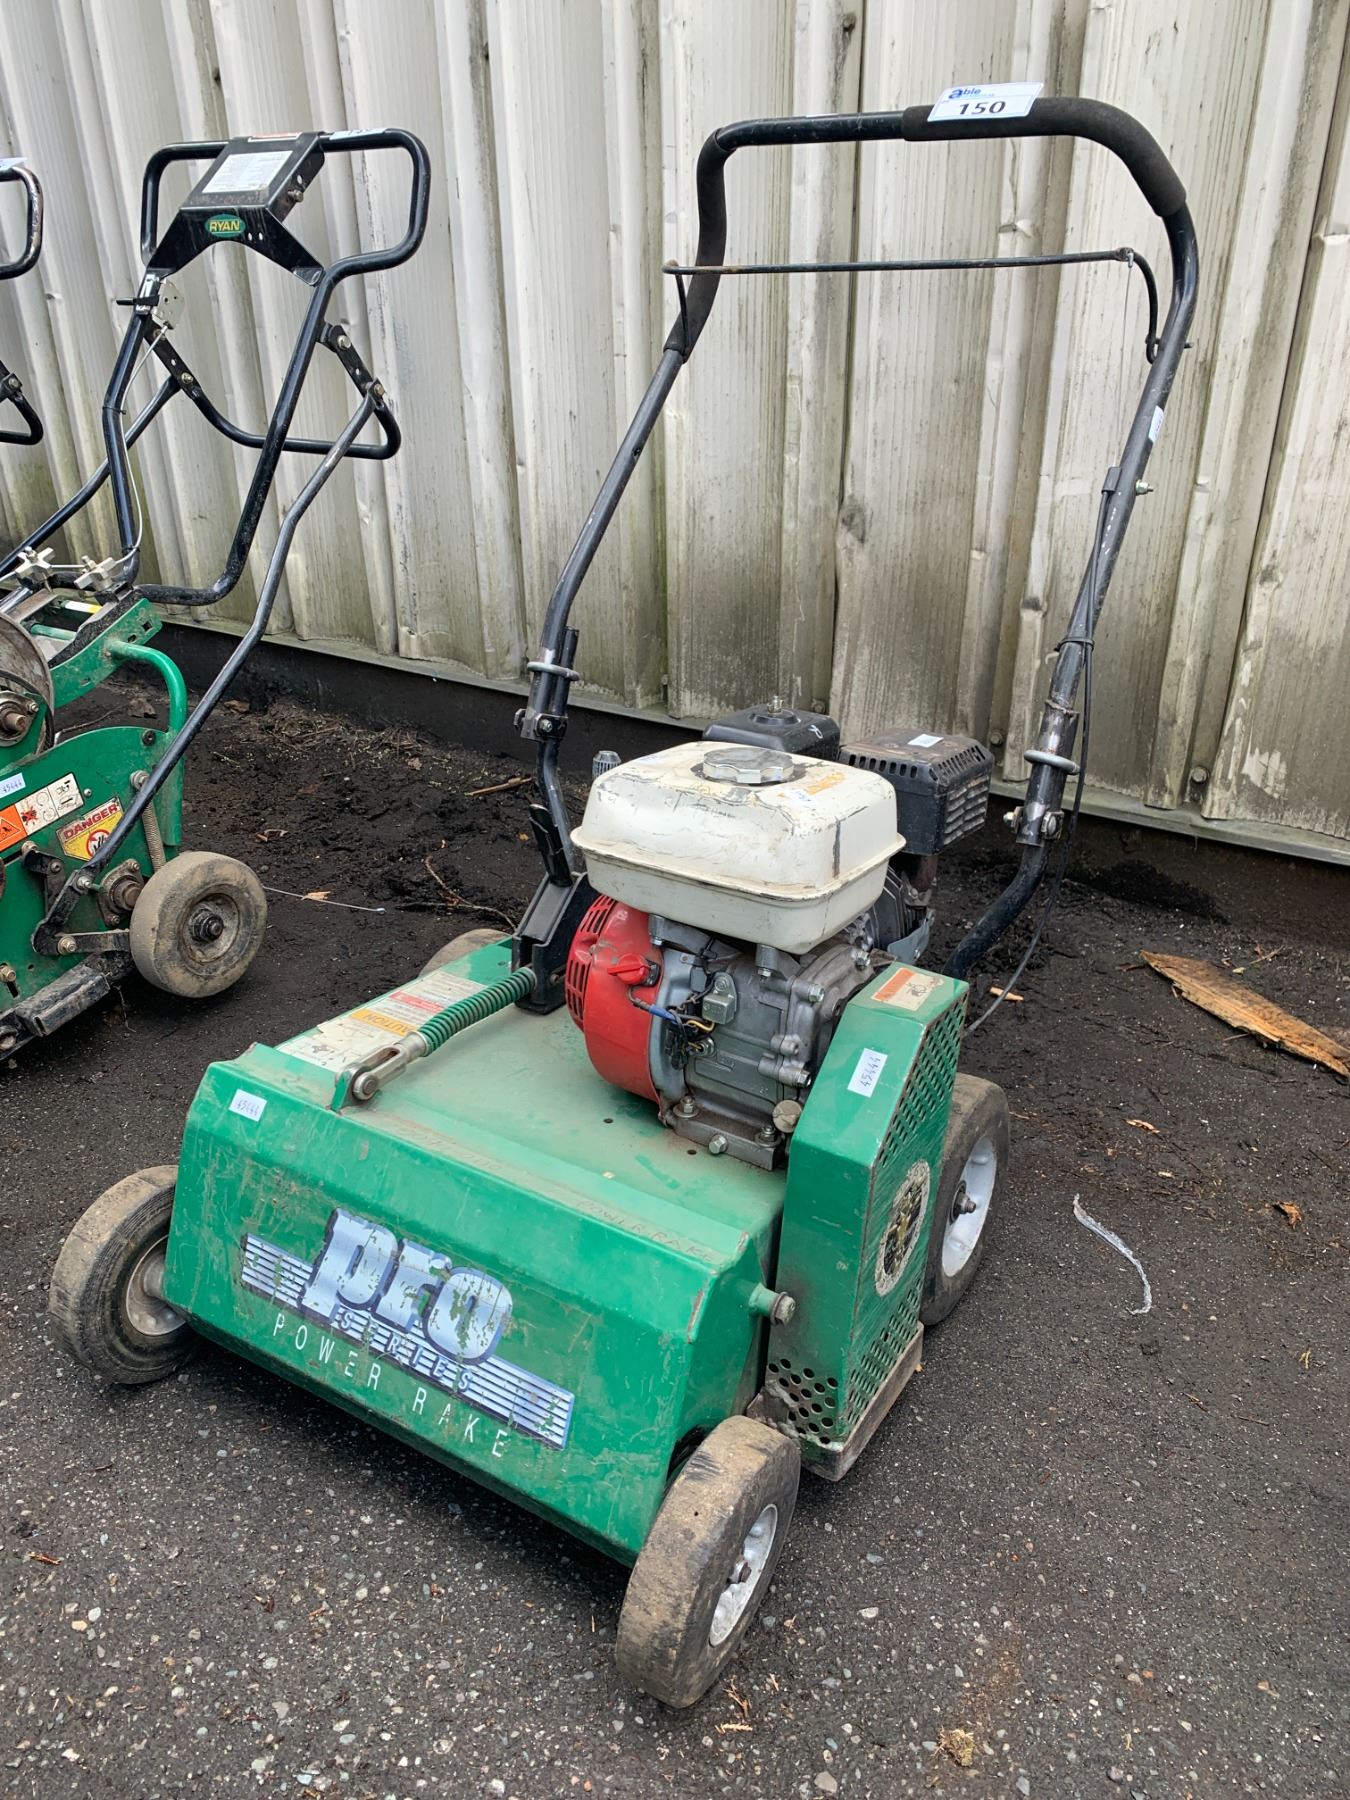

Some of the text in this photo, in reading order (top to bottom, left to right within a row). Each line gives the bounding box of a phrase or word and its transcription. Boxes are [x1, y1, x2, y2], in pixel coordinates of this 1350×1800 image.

[948, 88, 982, 100] able
[959, 101, 1006, 116] 150
[209, 220, 240, 232] RYAN
[63, 804, 118, 839] DANGER
[341, 1311, 473, 1393] SERIES
[272, 1313, 510, 1459] POWER RAKE
